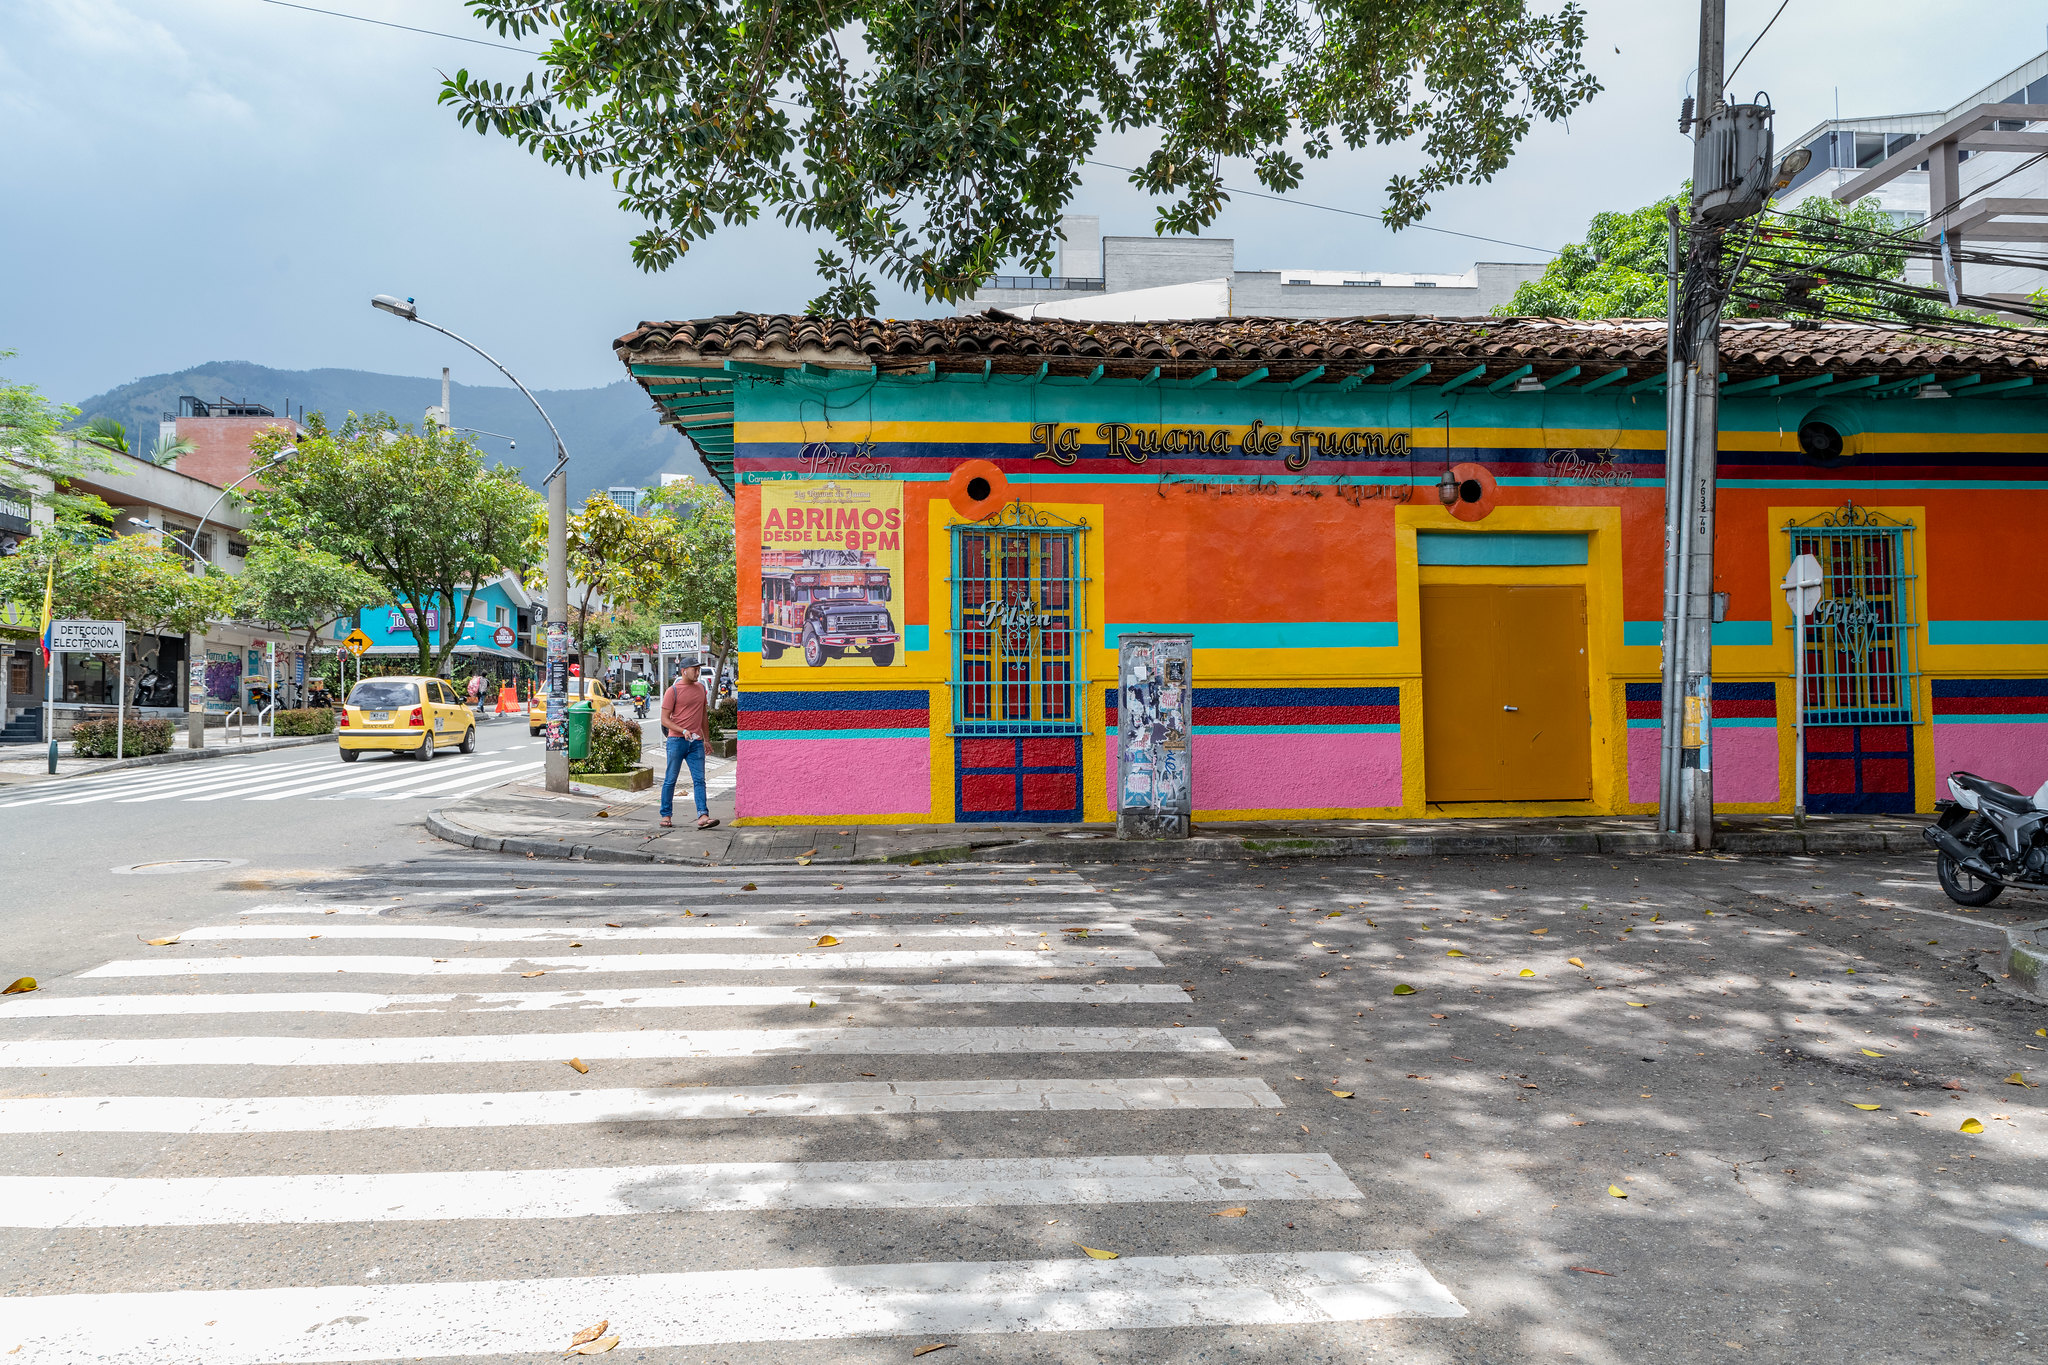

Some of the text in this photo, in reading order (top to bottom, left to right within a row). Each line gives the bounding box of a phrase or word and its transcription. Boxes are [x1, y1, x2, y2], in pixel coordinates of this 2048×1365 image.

[1031, 419, 1412, 471] La Ruana de Juana
[798, 440, 893, 481] Pilsen
[1547, 449, 1633, 486] Pilsen
[781, 473, 793, 481] 42
[764, 508, 902, 530] ABRIMOS
[764, 530, 900, 550] DESDE LAS 8PM
[978, 600, 1051, 628] Pilsen
[1815, 599, 1880, 625] Pilsen
[60, 624, 114, 636] DETECCIÓN
[665, 627, 695, 638] DETECCIÓN
[53, 636, 120, 648] ELECTRÓNICA
[662, 639, 697, 650] ELECTRÓNICA
